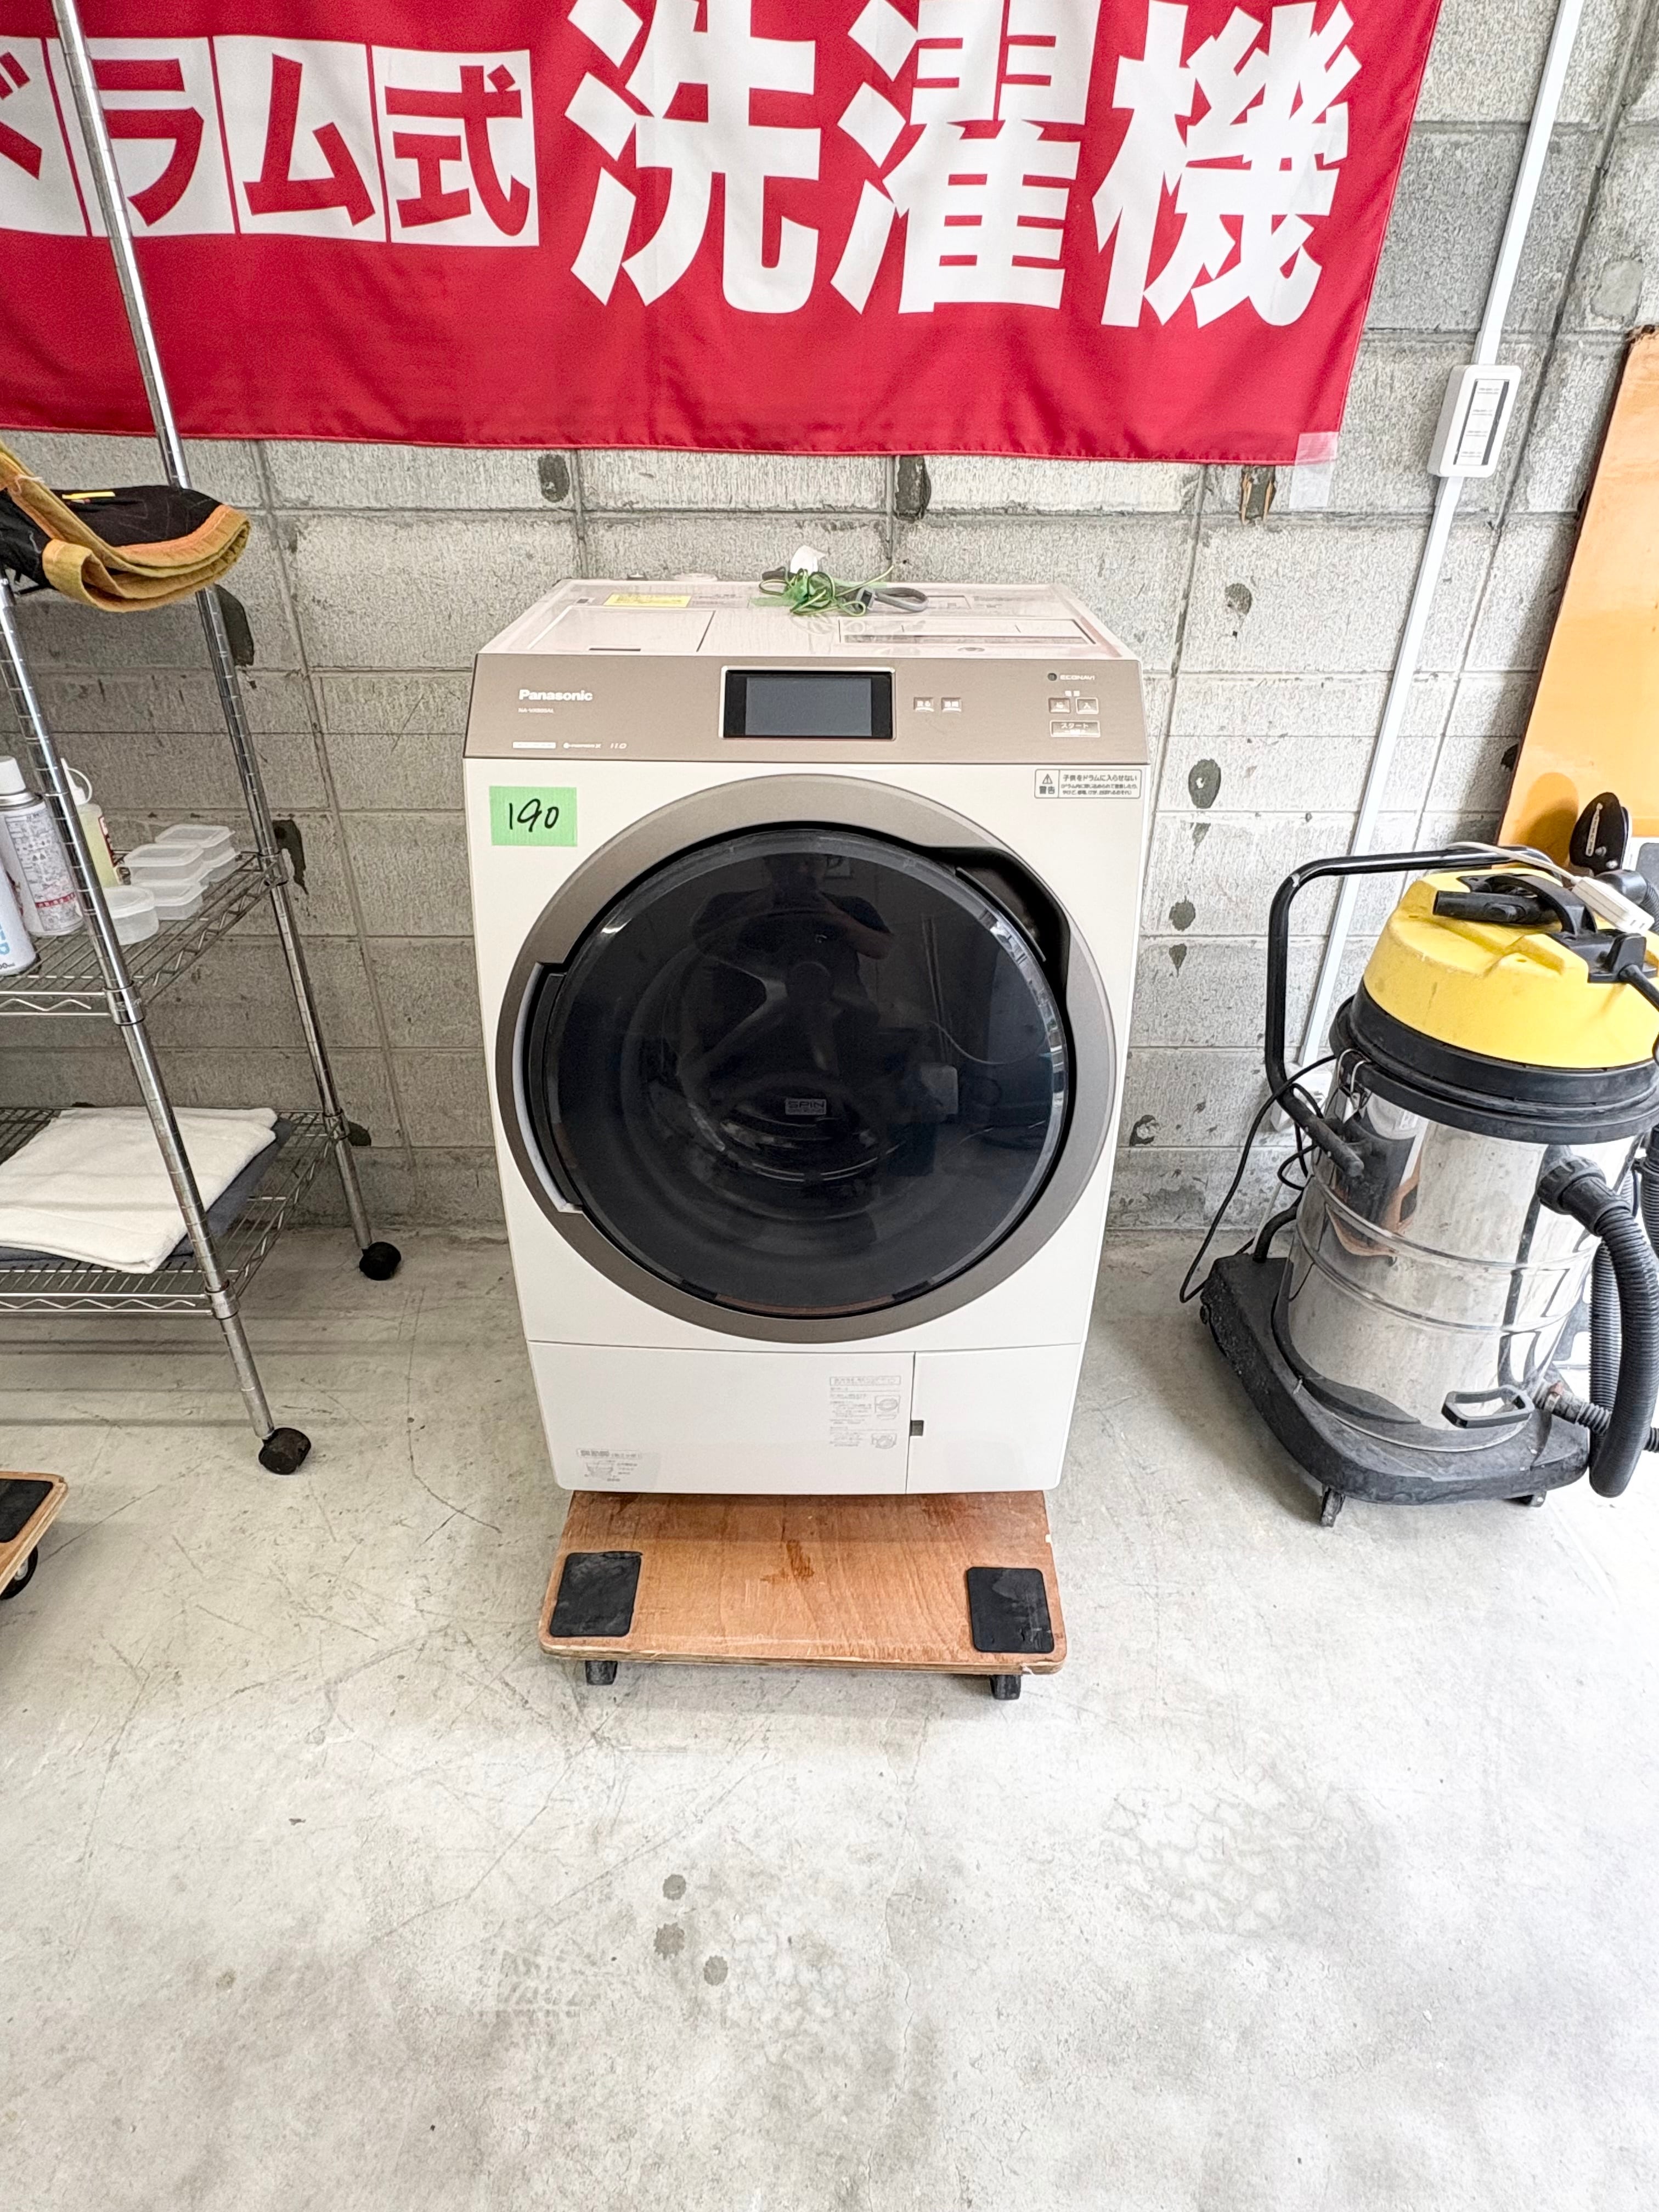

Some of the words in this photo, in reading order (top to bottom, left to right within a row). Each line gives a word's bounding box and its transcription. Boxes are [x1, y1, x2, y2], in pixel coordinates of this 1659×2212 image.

[564, 0, 1362, 328] 洗濯機
[518, 689, 593, 701] Panasonic
[509, 798, 560, 833] 190
